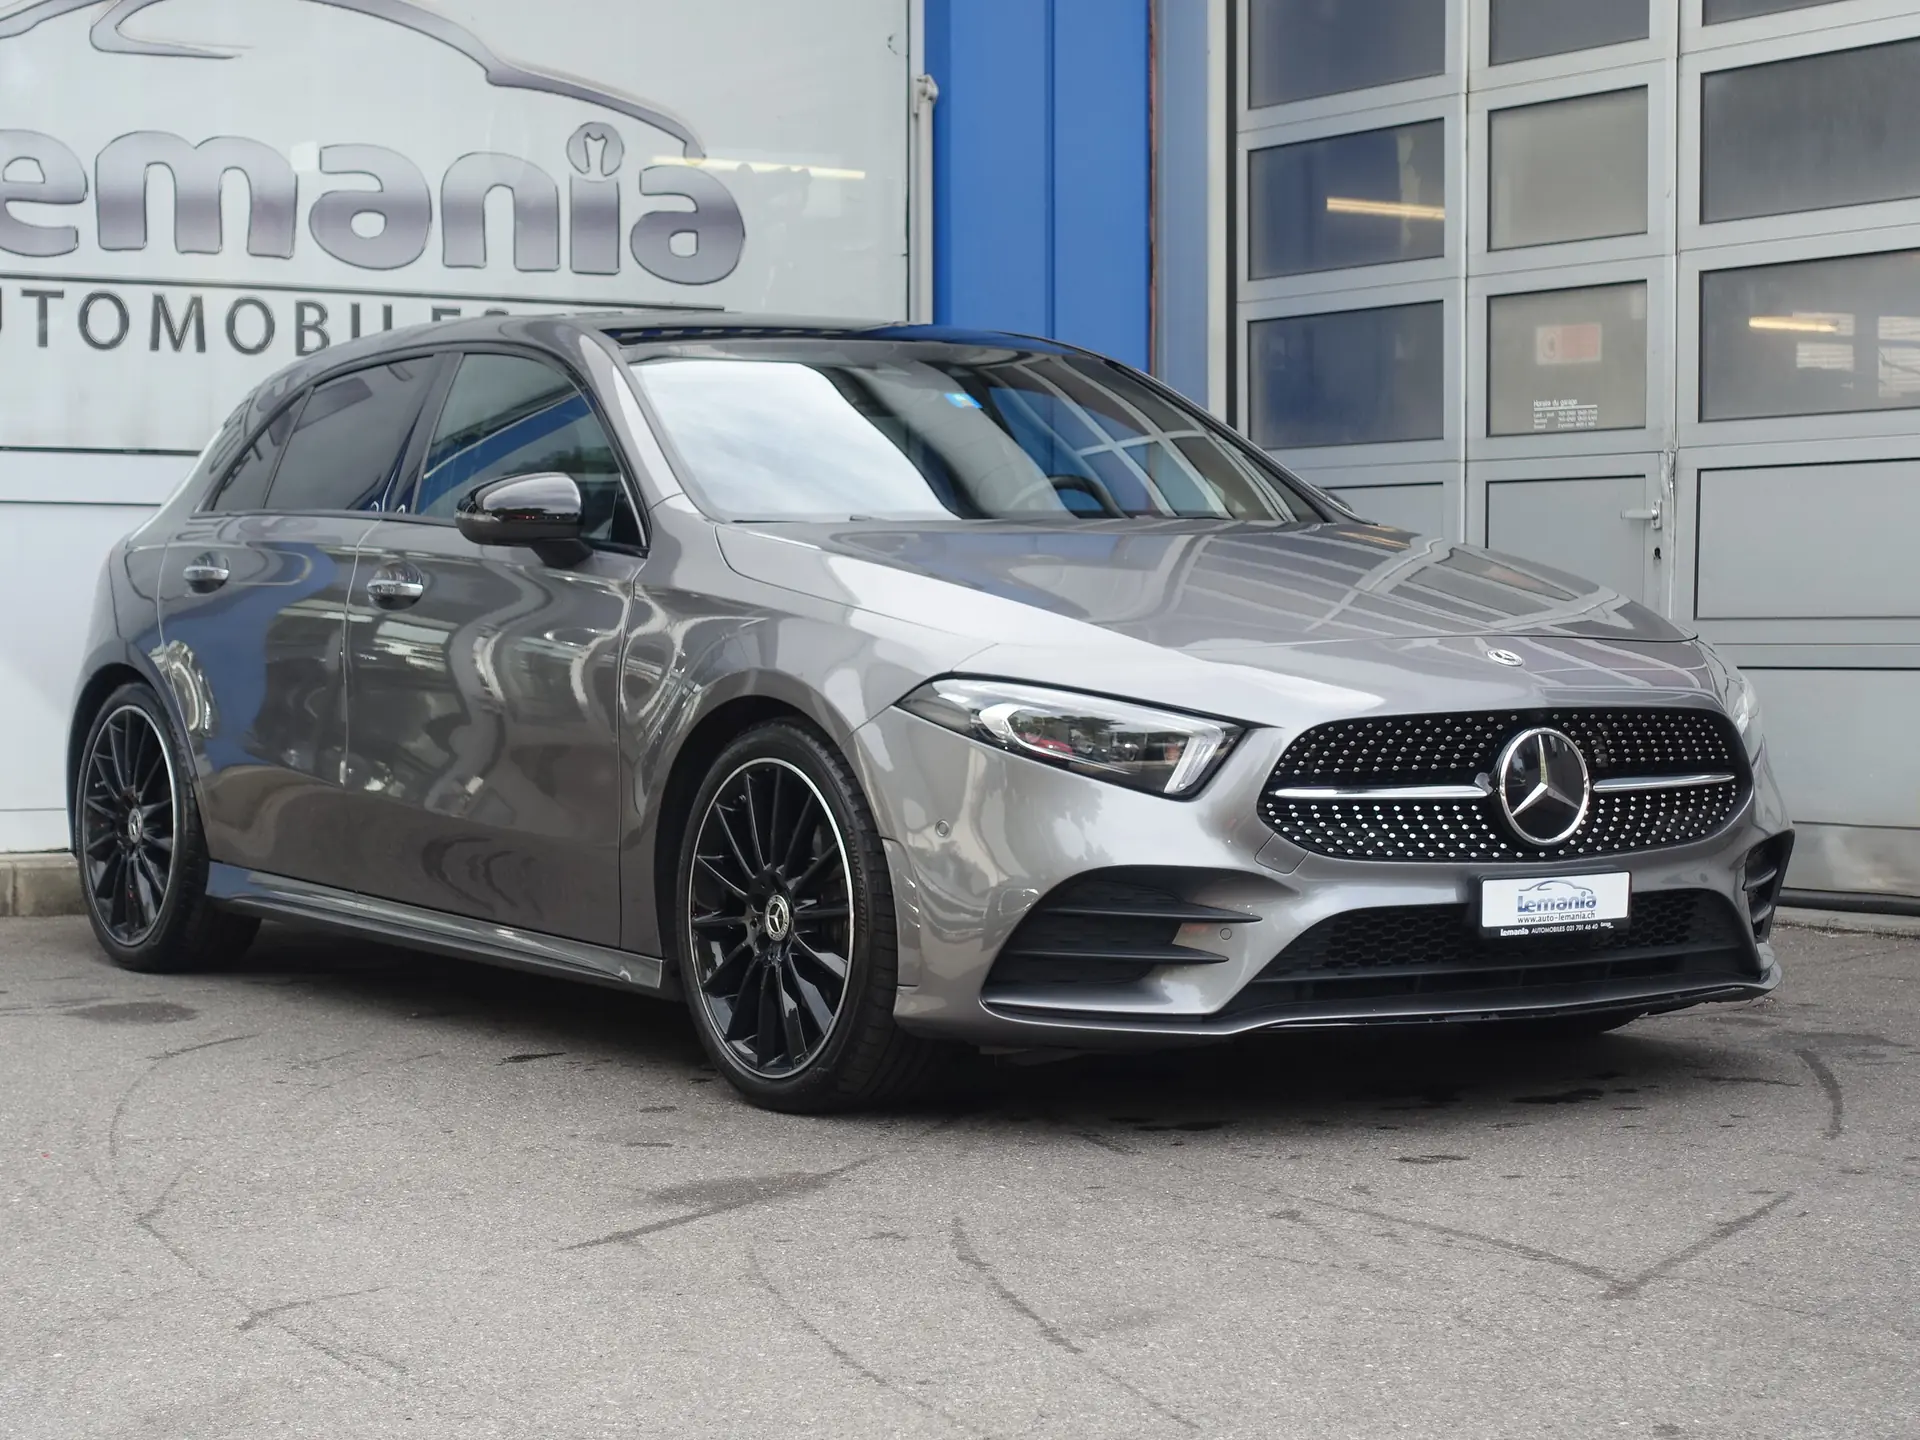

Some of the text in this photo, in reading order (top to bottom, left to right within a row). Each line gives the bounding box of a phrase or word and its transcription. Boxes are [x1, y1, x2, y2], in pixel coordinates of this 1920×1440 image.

[1517, 891, 1597, 912] Lemania
[1517, 911, 1596, 924] www.auto-lemania.ch
[1531, 925, 1565, 934] AUTOMOBILES
